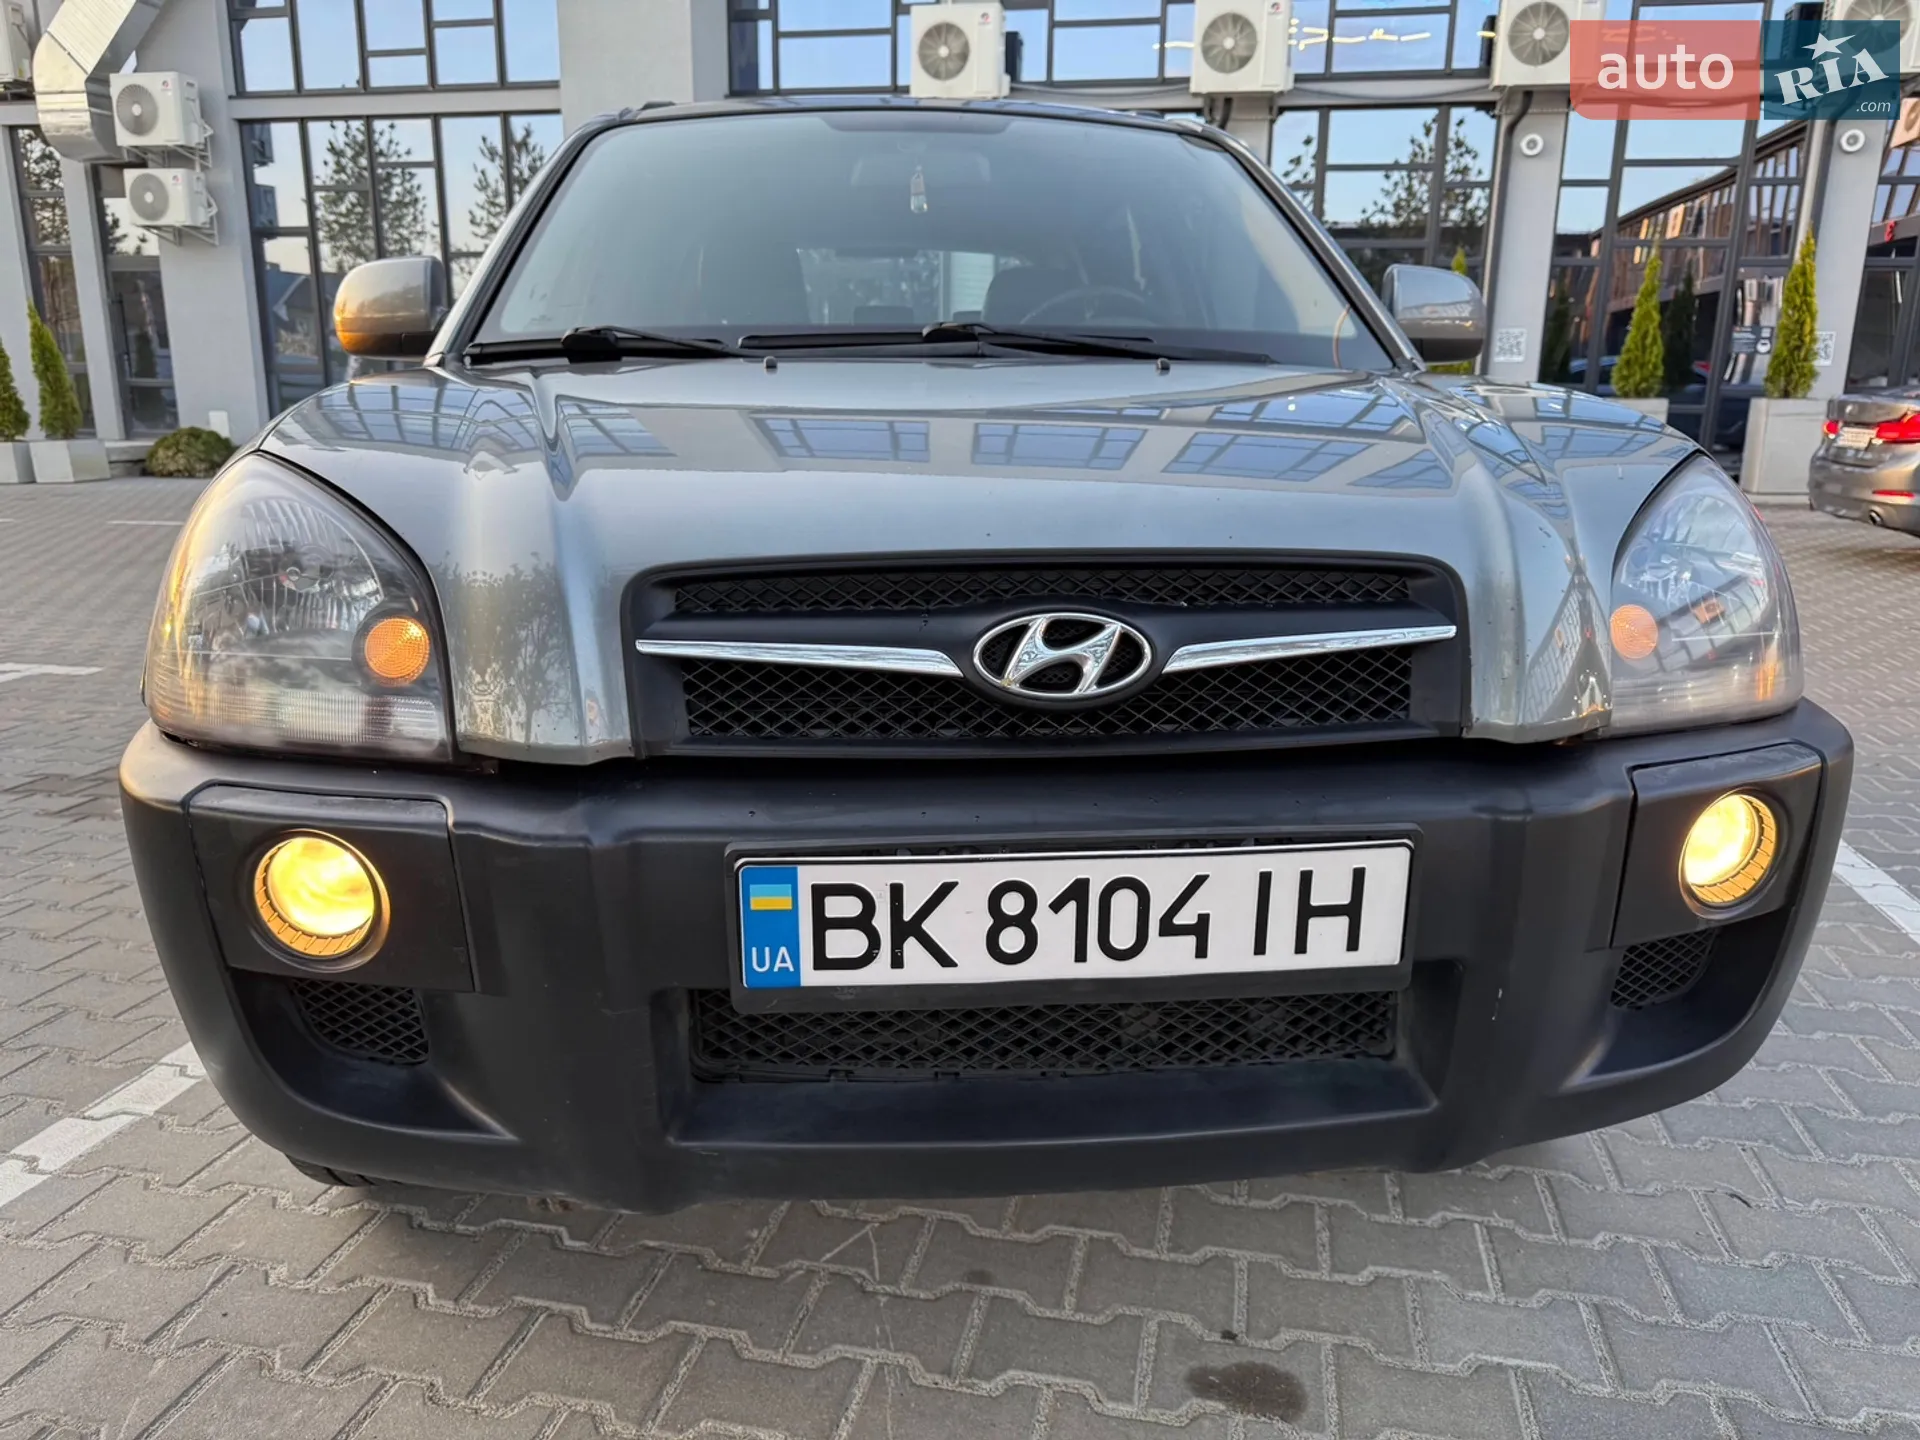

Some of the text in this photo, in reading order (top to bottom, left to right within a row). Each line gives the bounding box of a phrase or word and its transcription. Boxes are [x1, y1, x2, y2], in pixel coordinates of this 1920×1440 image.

[810, 866, 1366, 971] BK 8104 IH
[750, 945, 795, 973] UA
